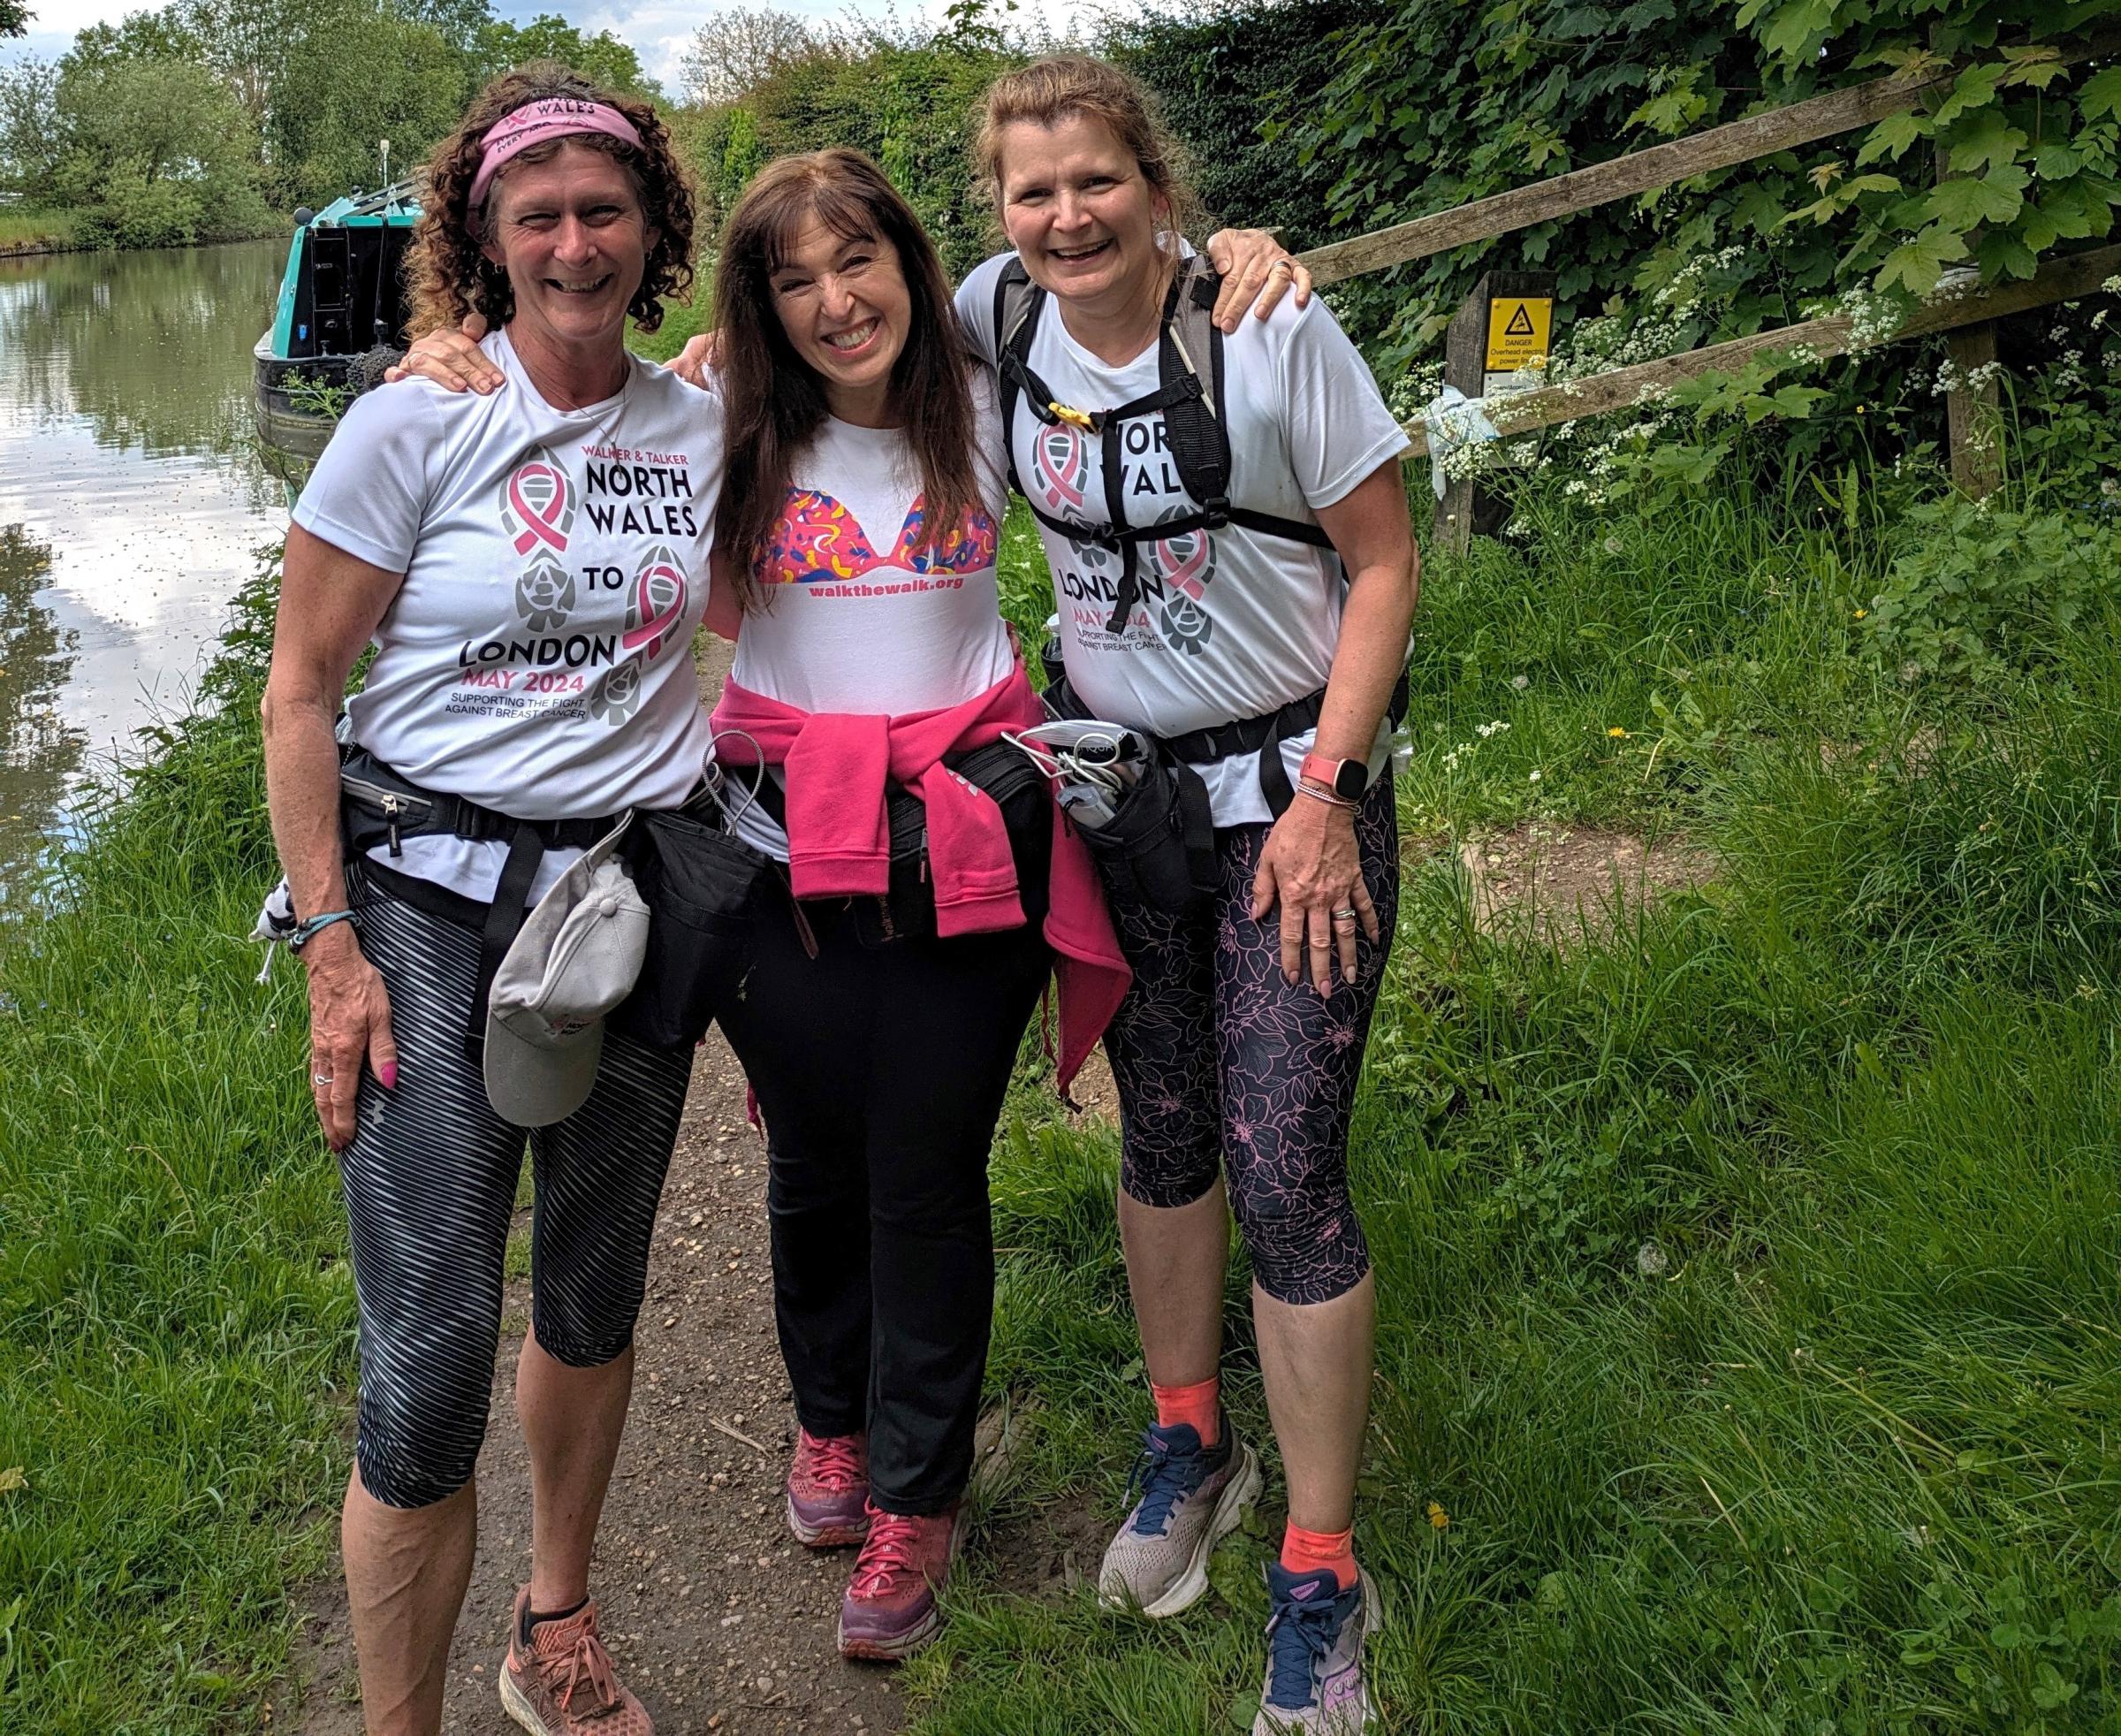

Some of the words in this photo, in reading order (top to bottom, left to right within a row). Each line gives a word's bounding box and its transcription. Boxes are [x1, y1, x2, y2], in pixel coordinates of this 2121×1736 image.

[497, 131, 524, 153] EVERY
[582, 445, 631, 461] WALKER
[635, 450, 643, 461] &
[646, 451, 689, 465] TALKER
[587, 461, 693, 498] NORTH
[585, 503, 698, 537] WALES
[582, 567, 624, 590] TO
[809, 576, 963, 597] walkthewalk.org
[1072, 606, 1102, 626] MAY
[1103, 643, 1132, 651] BREAST
[1135, 641, 1168, 651] CANER
[1118, 631, 1137, 642] THE
[1139, 630, 1159, 641] FIHT
[459, 635, 617, 667] LONDON
[460, 668, 519, 689] MAY
[523, 672, 584, 693] 2024
[451, 692, 524, 707] SUPPORTING
[528, 698, 549, 707] THE
[552, 698, 585, 707] FIGHT
[445, 704, 493, 716] AGAINST
[496, 708, 538, 719] BREAST
[542, 709, 586, 719] CANCER
